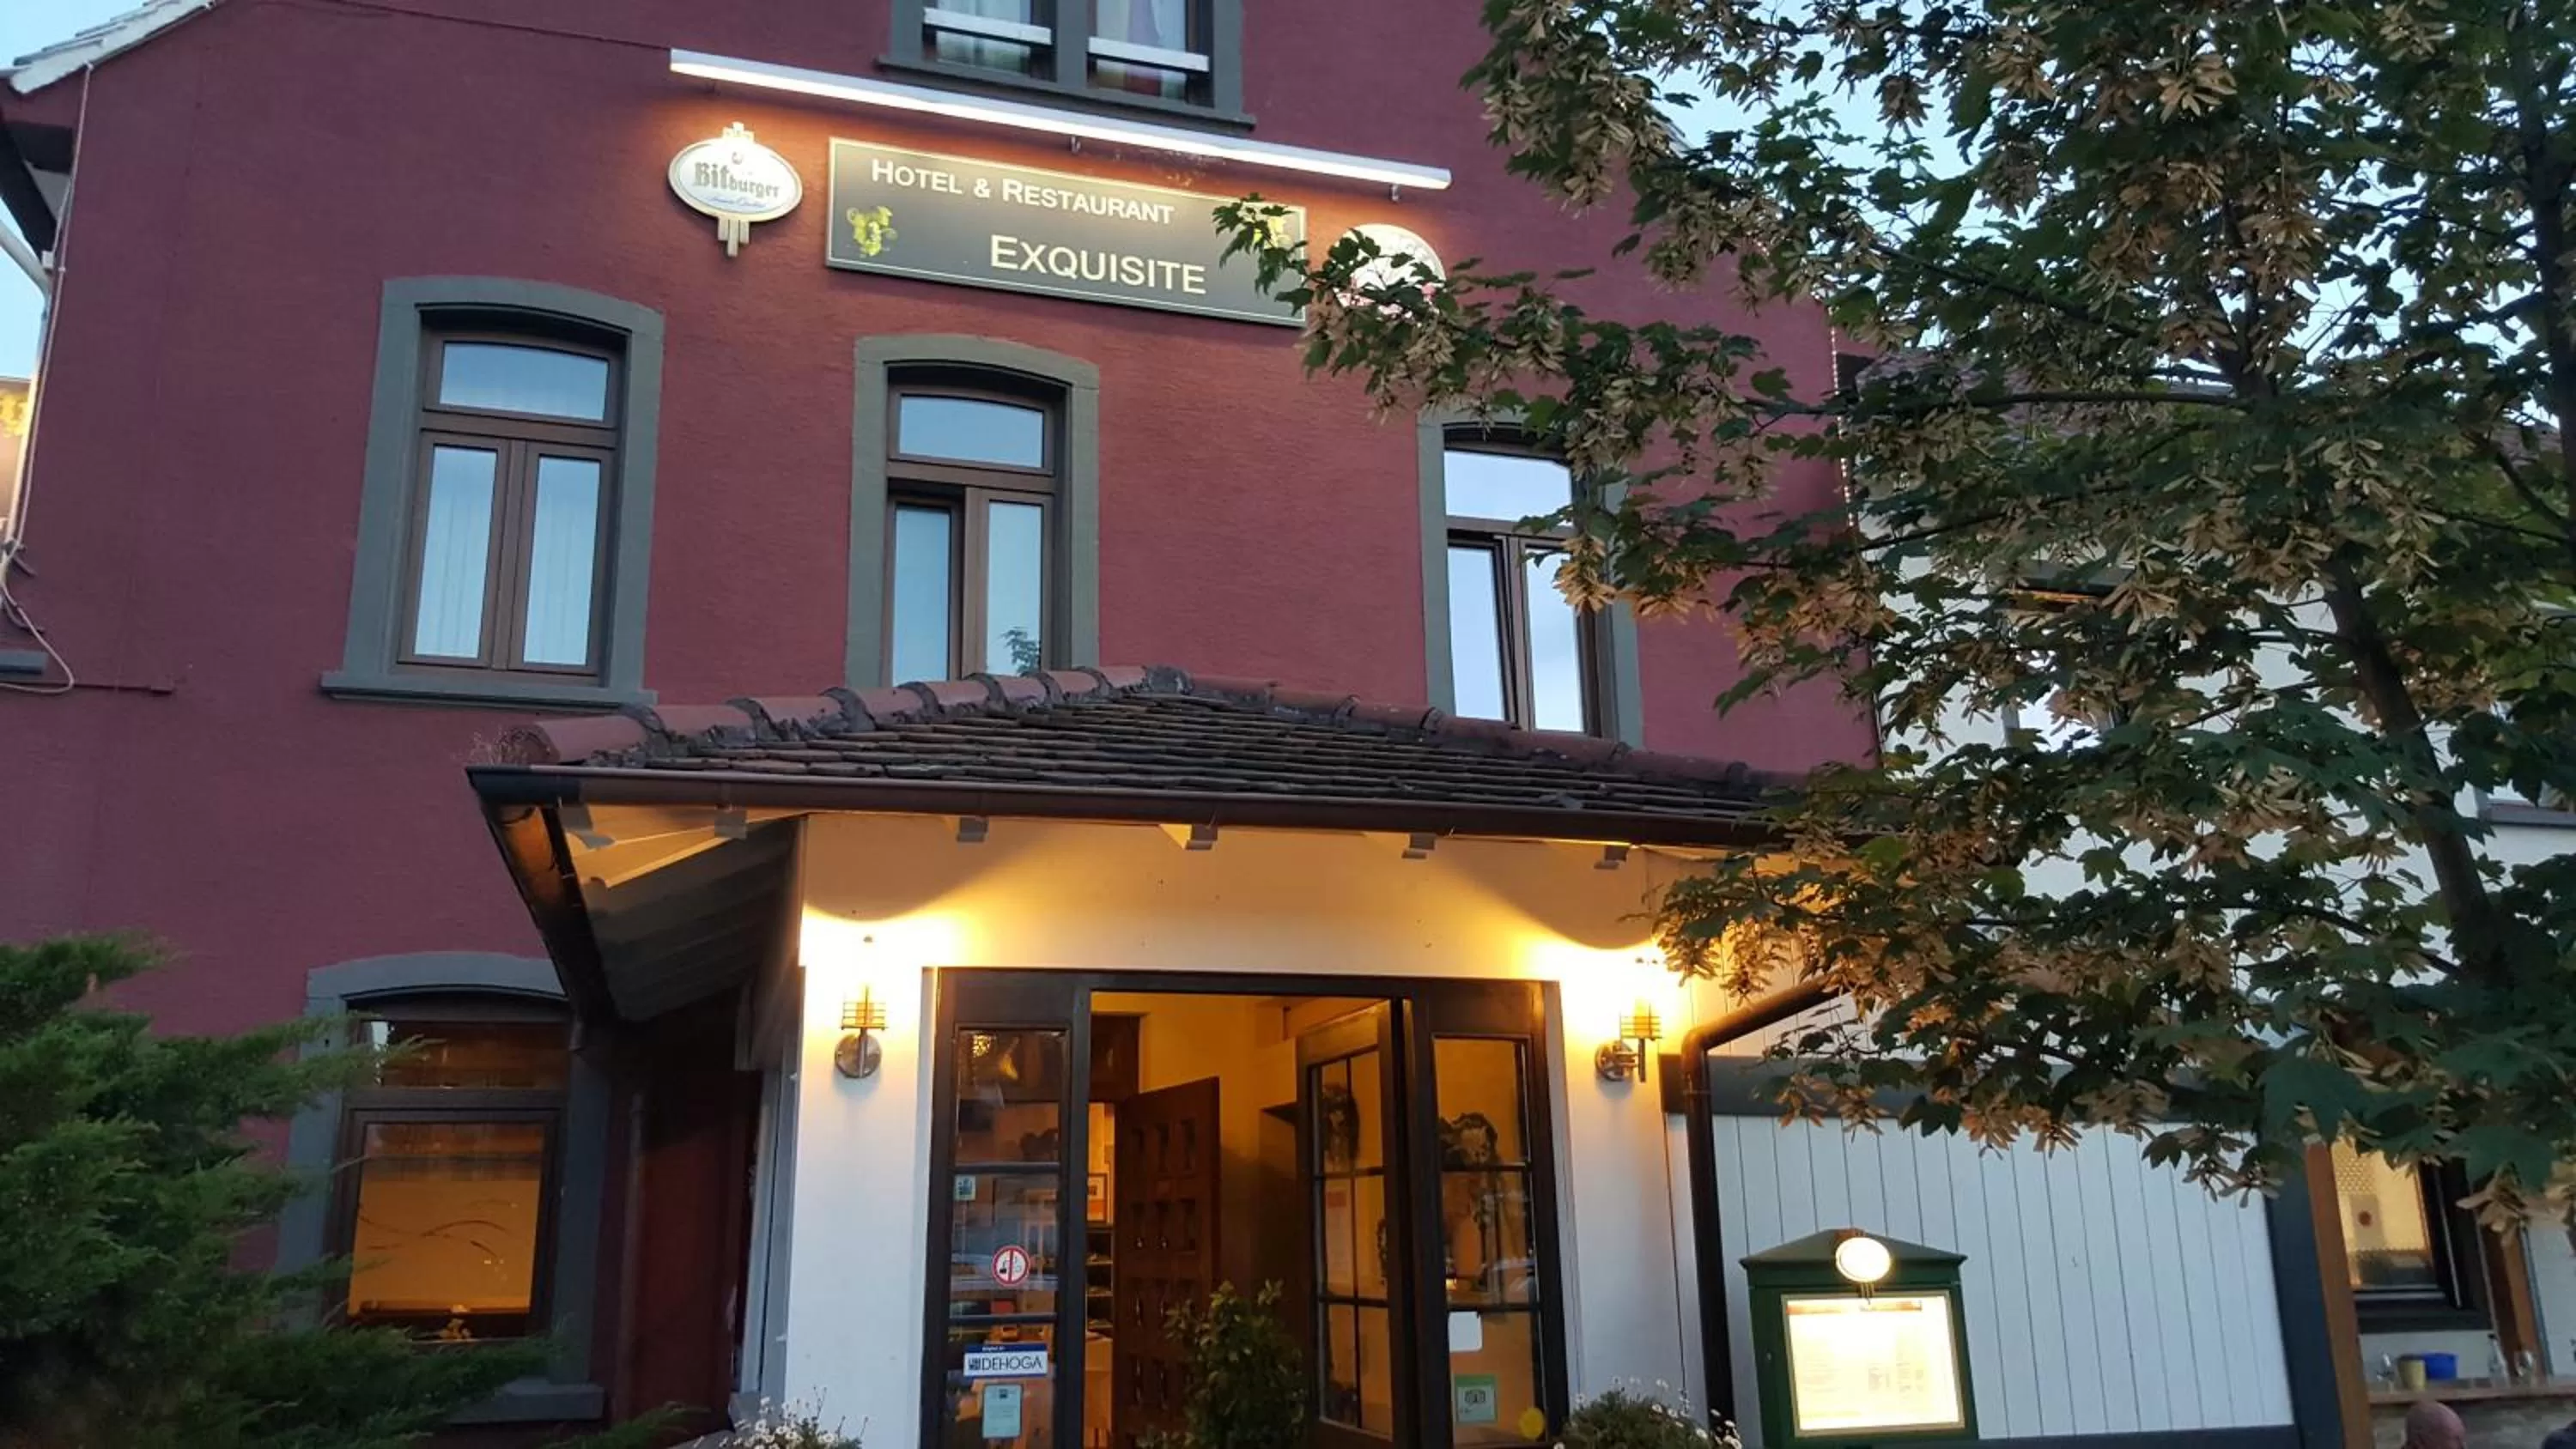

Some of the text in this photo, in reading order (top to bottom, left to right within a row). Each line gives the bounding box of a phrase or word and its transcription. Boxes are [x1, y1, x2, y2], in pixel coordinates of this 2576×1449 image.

[693, 161, 781, 198] Bitburger
[872, 159, 1175, 225] HOTEL & RESTAURANT
[990, 234, 1207, 294] EXQUISITE
[981, 1355, 1042, 1371] DEHOGA
